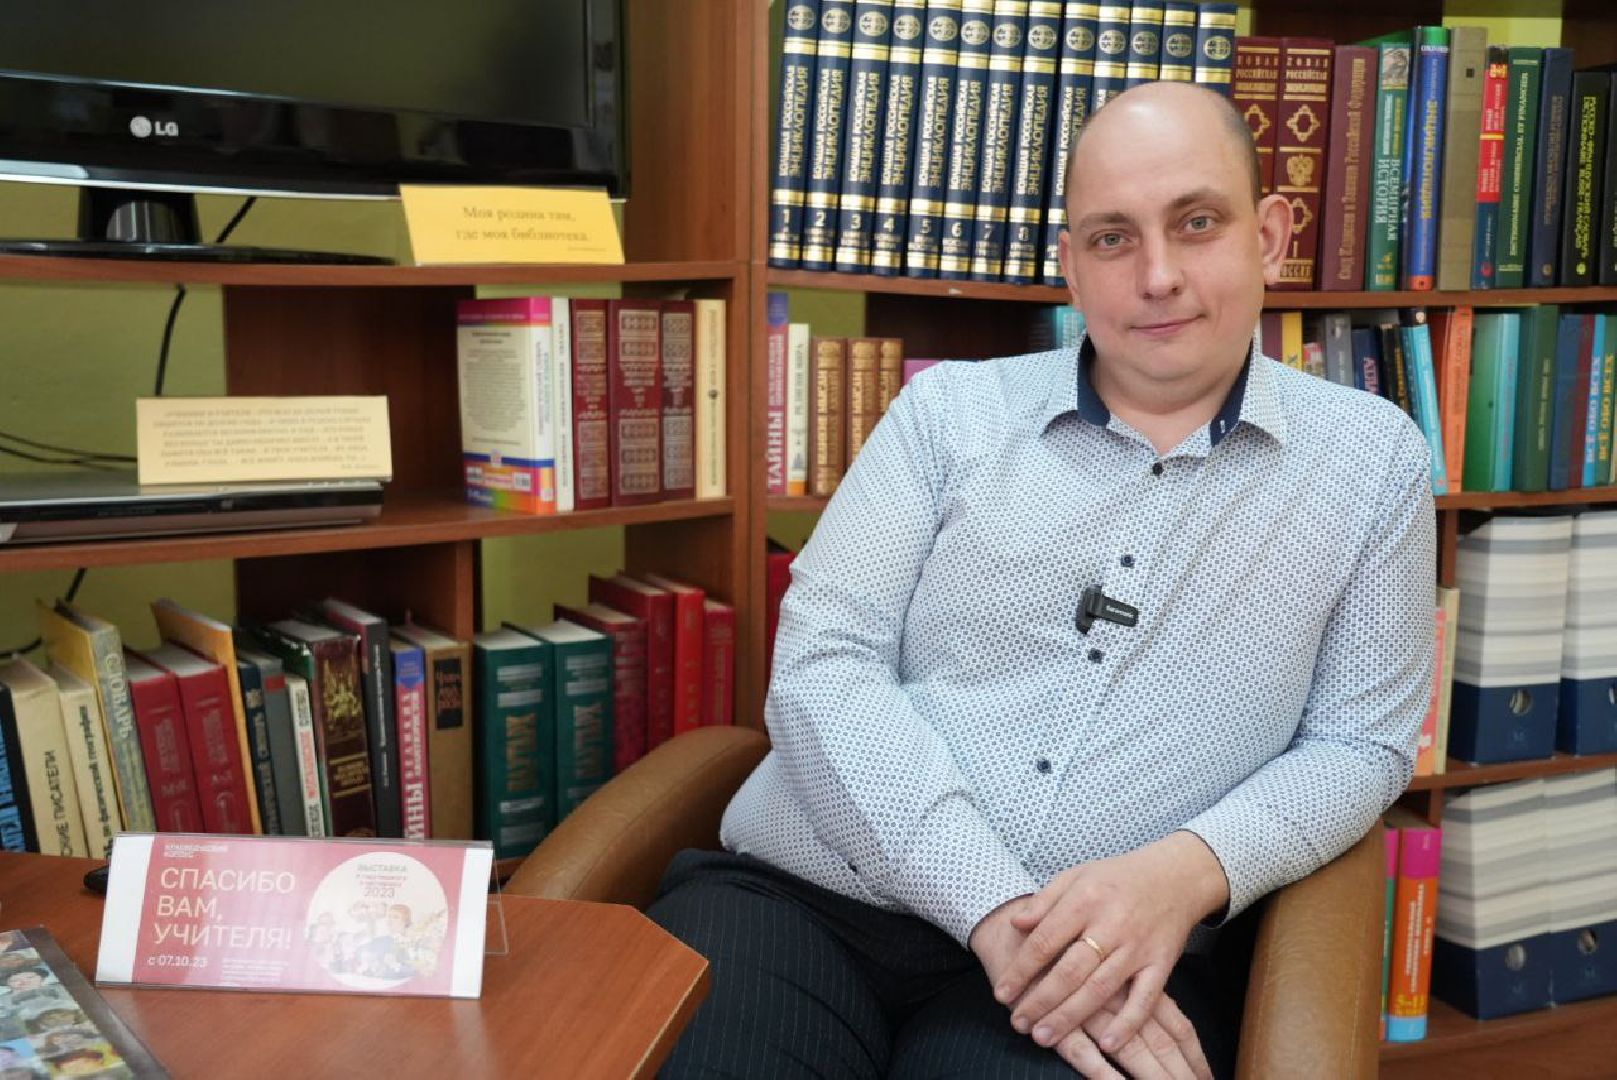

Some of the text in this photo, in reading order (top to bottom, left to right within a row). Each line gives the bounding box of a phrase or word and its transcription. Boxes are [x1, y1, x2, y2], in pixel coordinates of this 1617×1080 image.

[155, 121, 179, 137] LG
[779, 65, 795, 176] БОЛЬШАЯ РОССИЙСКАЯ
[788, 68, 808, 177] ЭНЦИКЛОПЕДИЯ
[813, 68, 829, 179] БОЛЬШАЯ РОССИЙСКАЯ
[823, 69, 843, 180] ЭНЦИКЛОПЕДИЯ
[849, 72, 866, 181] БОЛЬШАЯ РОССИЙСКАЯ
[860, 73, 880, 184] ЭНЦИКЛОПЕДИЯ
[882, 75, 900, 185] БОЛЬШАЯ РОССИЙСКАЯ
[893, 75, 913, 186] ЭНЦИКЛОПЕДИЯ
[919, 77, 936, 186] БОЛЬШАЯ РОССИЙСКАЯ
[929, 77, 949, 188] ЭНЦИКЛОПЕДИЯ
[950, 79, 968, 190] БОЛЬШАЯ РОССИЙСКАЯ
[960, 81, 980, 191] ЭНЦИКЛОПЕДИЯ
[981, 82, 1000, 193] БОЛЬШАЯ РОССИЙСКАЯ
[992, 83, 1013, 193] ЭНЦИКЛОПЕДИЯ
[1016, 84, 1035, 195] БОЛЬШАЯ РОССИЙСКАЯ
[1028, 86, 1048, 195] ЭНЦИКЛОПЕДИЯ
[1421, 101, 1438, 219] ЭНЦИКЛОПЕДИЯ
[463, 206, 493, 219] Моя
[783, 208, 790, 224] 1
[815, 209, 826, 227] 2
[851, 213, 861, 229] 3
[883, 218, 894, 232] 4
[921, 218, 931, 233] 5
[951, 222, 961, 237] 6
[984, 223, 992, 239] 7
[1375, 159, 1390, 224] ИСТОРИЯ
[1386, 159, 1400, 241] ВСЕМИРНАЯ
[482, 231, 508, 240] моя
[1018, 226, 1029, 241] 8
[768, 411, 784, 488] ТАЙНЫ
[105, 653, 134, 738] СЛОВАРЬ
[45, 751, 64, 820] ПИСАТЕЛИ
[157, 895, 223, 921] ВАМ,
[160, 867, 296, 894] СПАСИБО
[147, 955, 208, 968] с 07.10.23
[154, 922, 291, 949] УЧИТЕЛЯ!
